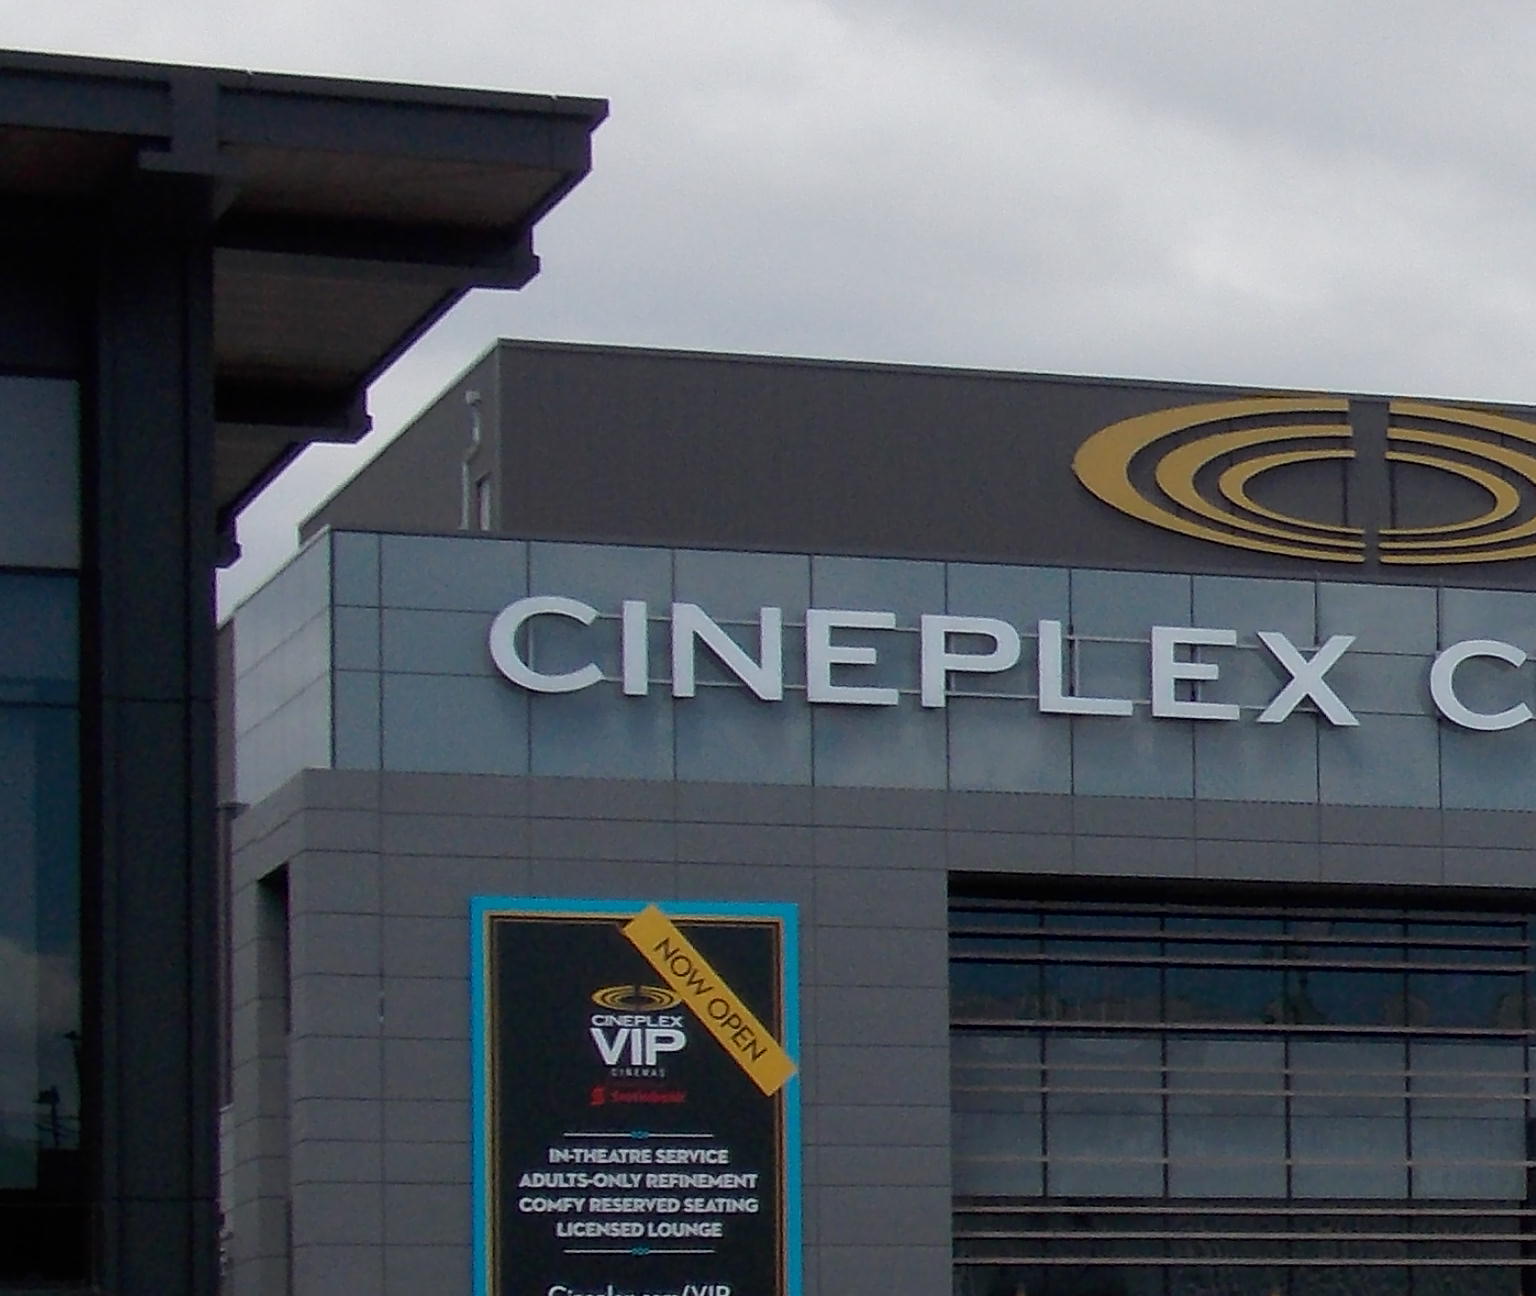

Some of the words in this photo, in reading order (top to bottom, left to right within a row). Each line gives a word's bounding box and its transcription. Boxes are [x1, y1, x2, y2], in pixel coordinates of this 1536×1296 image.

[488, 595, 1361, 727] CINEPLEX
[652, 937, 714, 996] NOW
[707, 996, 768, 1062] OPEN
[591, 1014, 683, 1028] CINEPLEX
[590, 1028, 687, 1066] VIP
[549, 1148, 652, 1164] IN-THEATRE
[655, 1148, 729, 1165] SERVICE
[518, 1173, 643, 1189] ADULTS-ONLY
[646, 1173, 759, 1189] REFINEMENT
[518, 1197, 586, 1213] COMFY
[589, 1197, 681, 1213] RESERVED
[683, 1198, 760, 1213] SEATING
[556, 1222, 644, 1238] LICENSED
[648, 1222, 724, 1238] LOUNGE
